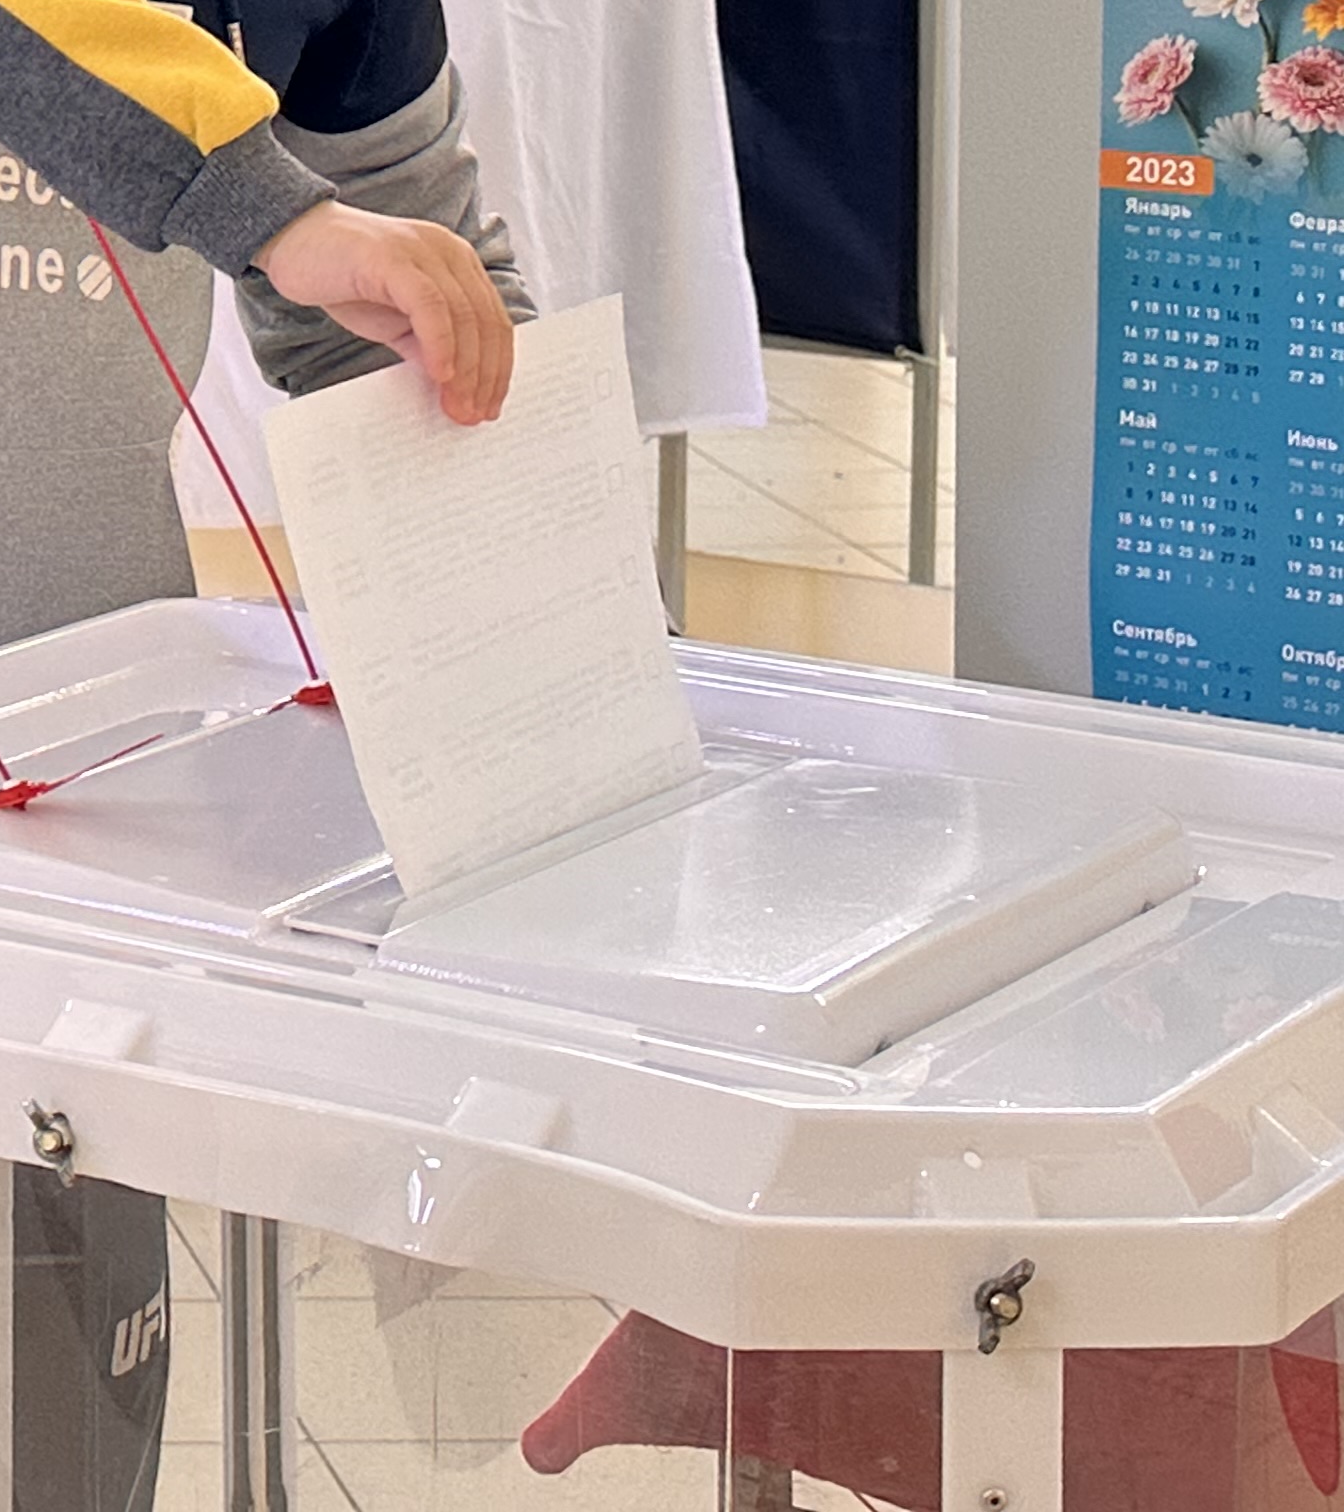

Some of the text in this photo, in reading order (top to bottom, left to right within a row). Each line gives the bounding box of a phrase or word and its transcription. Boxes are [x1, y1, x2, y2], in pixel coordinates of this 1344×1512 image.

[1126, 156, 1195, 186] 2023
[1125, 196, 1192, 220] Январь
[1296, 291, 1305, 304] 6
[1317, 293, 1325, 305] 7
[1131, 300, 1260, 325] 9 10 11 12 13 14 15
[1290, 317, 1305, 330] 13
[1310, 319, 1325, 332] 14
[1124, 325, 1259, 351] 16 17 18 19 20 21 22
[1288, 343, 1304, 357] 20
[1309, 345, 1323, 358] 21
[1122, 351, 1138, 365] 23
[1143, 353, 1158, 366] 24
[1164, 355, 1179, 369] 25
[1184, 357, 1199, 371] 26
[1204, 360, 1219, 373] 27
[1245, 365, 1259, 377] 29
[1142, 379, 1157, 392] 31
[1288, 370, 1325, 385] 27 28
[1119, 409, 1157, 429] Май
[1287, 429, 1338, 451] Июнь
[1146, 490, 1154, 501] 9
[1161, 491, 1175, 504] 10
[1181, 493, 1195, 507] 11
[1202, 496, 1216, 509] 12
[1224, 499, 1237, 512] 13
[1244, 502, 1258, 514] 14
[1118, 512, 1256, 540] 15 16 17 18 19 20 21
[1295, 508, 1344, 526] 5 6 7
[1116, 537, 1255, 567] 22 23 24 25 26 27 28
[1288, 534, 1344, 552] 12 13 14
[1115, 564, 1131, 577] 29
[1136, 566, 1152, 579] 30
[1156, 569, 1171, 583] 31
[1287, 560, 1343, 579] 19 20 21
[1285, 586, 1344, 606] 26 27 28
[1113, 619, 1198, 648] Сентябрь
